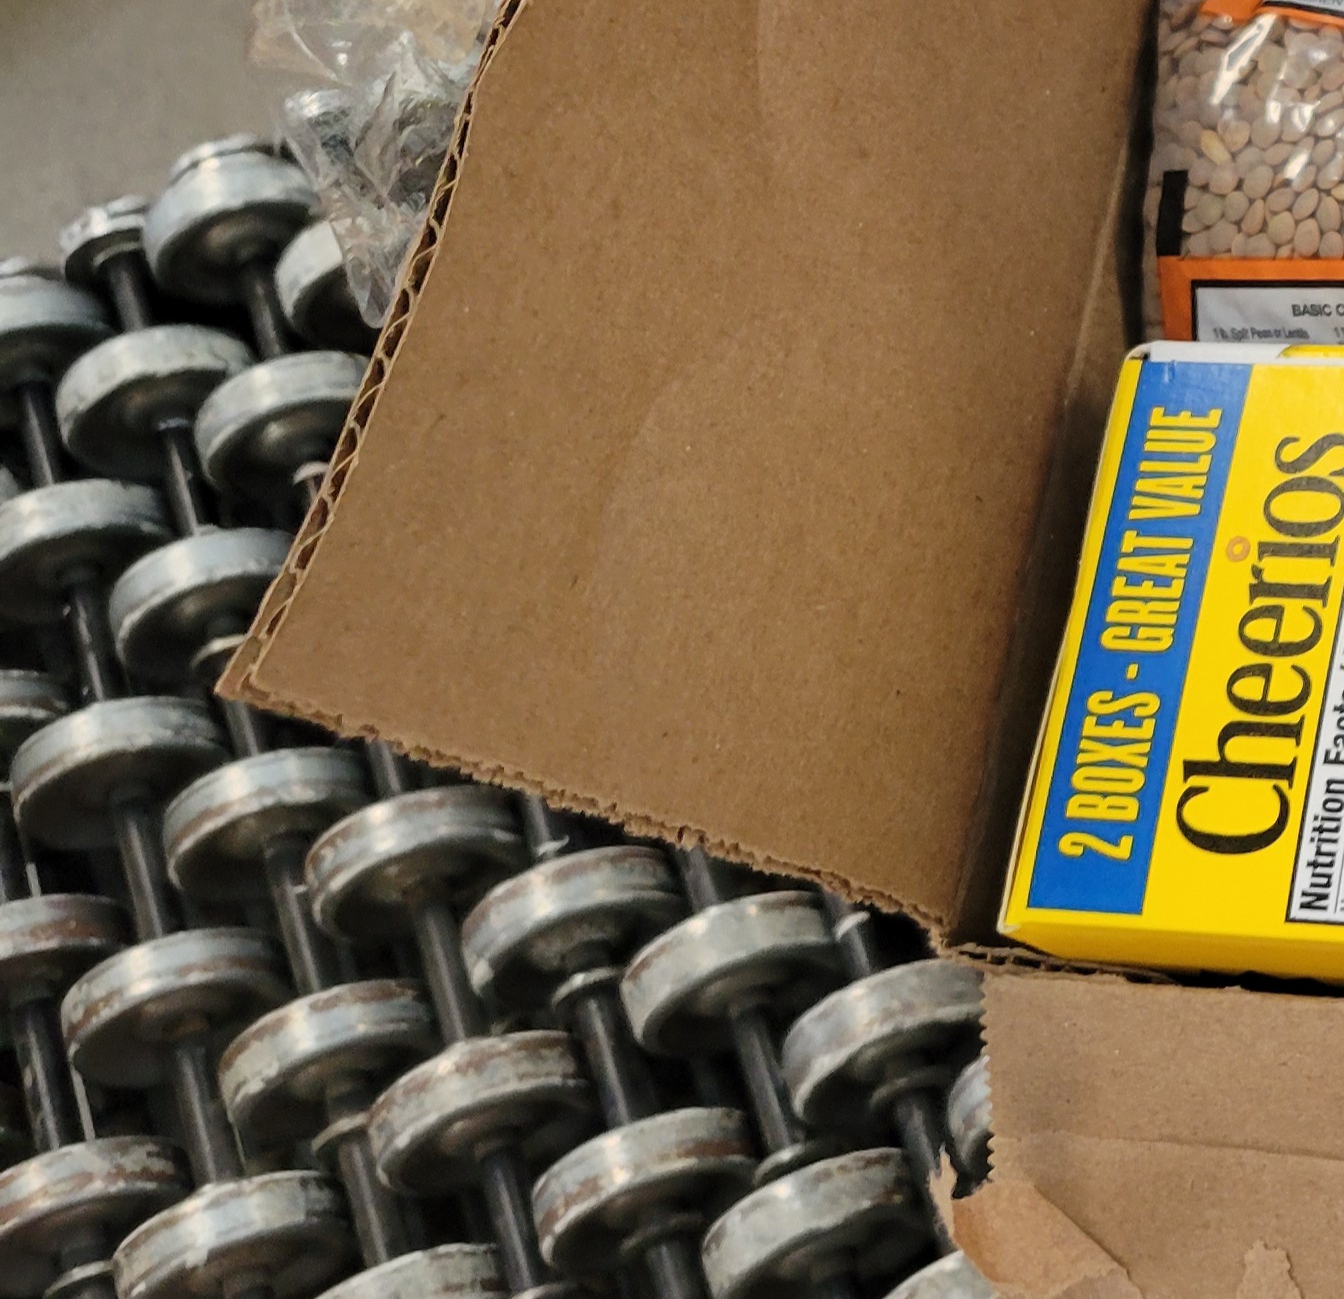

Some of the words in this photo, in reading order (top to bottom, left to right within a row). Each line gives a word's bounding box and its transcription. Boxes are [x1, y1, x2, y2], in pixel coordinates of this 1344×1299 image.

[1291, 302, 1333, 318] BASIC
[1133, 407, 1222, 519] VALUE
[1101, 530, 1194, 651] GREAT
[1067, 690, 1162, 821] BOXES
[1060, 833, 1134, 859] 2
